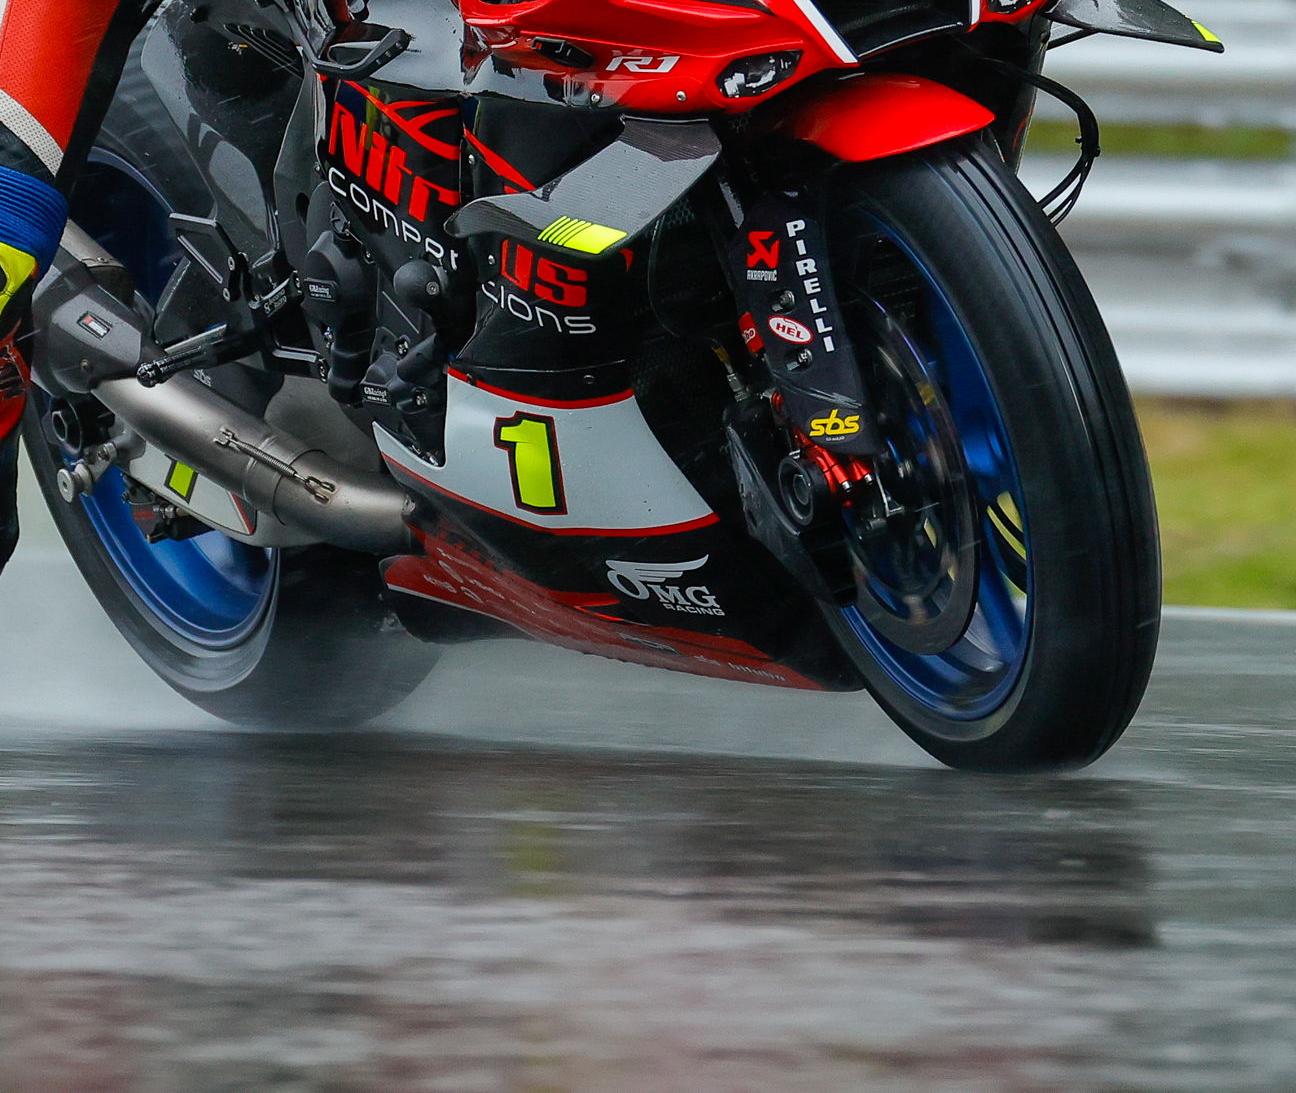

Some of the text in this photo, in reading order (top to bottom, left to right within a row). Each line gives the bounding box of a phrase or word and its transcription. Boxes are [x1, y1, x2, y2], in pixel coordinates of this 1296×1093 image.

[605, 55, 681, 73] R1
[785, 219, 835, 353] PIRELLI
[775, 322, 805, 340] HEL
[809, 408, 860, 437] sbs
[498, 417, 560, 511] 1
[606, 560, 721, 609] OMG
[663, 602, 726, 617] RACING
